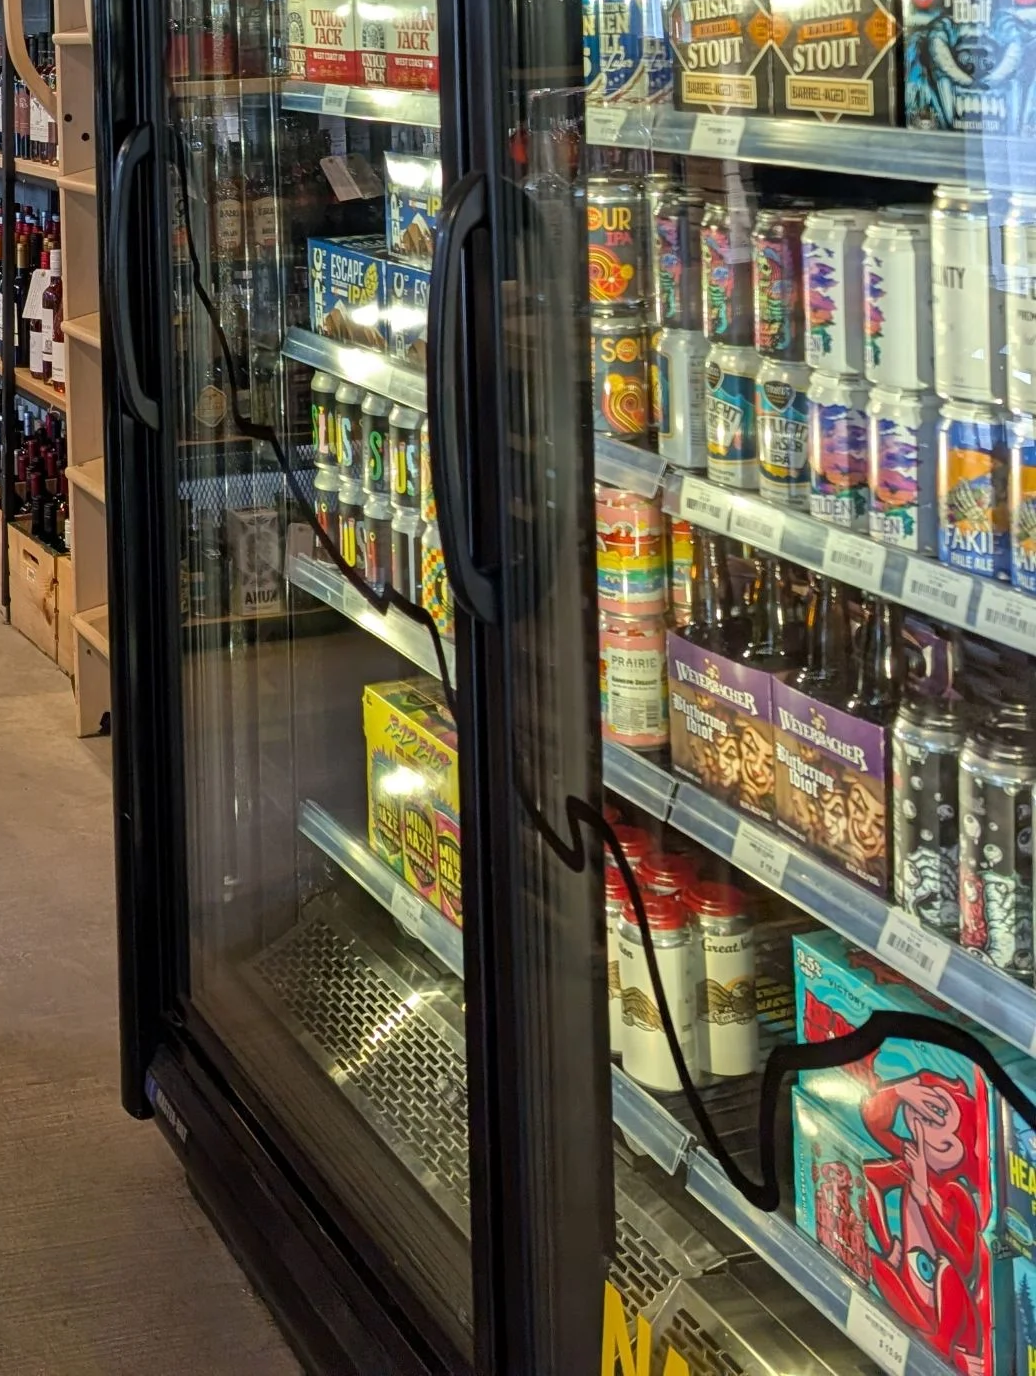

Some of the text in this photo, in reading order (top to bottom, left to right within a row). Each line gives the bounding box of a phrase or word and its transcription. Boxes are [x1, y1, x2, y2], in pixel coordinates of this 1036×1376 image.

[310, 10, 347, 28] UNION
[315, 27, 343, 46] JACK
[397, 31, 430, 51] JACK
[687, 37, 744, 70] STOUT
[793, 37, 861, 73] STOUT
[792, 86, 847, 102] BARREL-AGED
[587, 207, 632, 231] OUR
[605, 232, 633, 247] IPA
[330, 254, 364, 287] ESCAPE
[611, 655, 657, 669] PRAIRIE
[675, 660, 758, 716] WEYERBACHER
[778, 707, 868, 771] WEYERBACHER
[405, 809, 432, 845] MIND
[406, 827, 433, 864] HAZE
[702, 936, 740, 954] Great
[828, 978, 865, 1008] VICTORY
